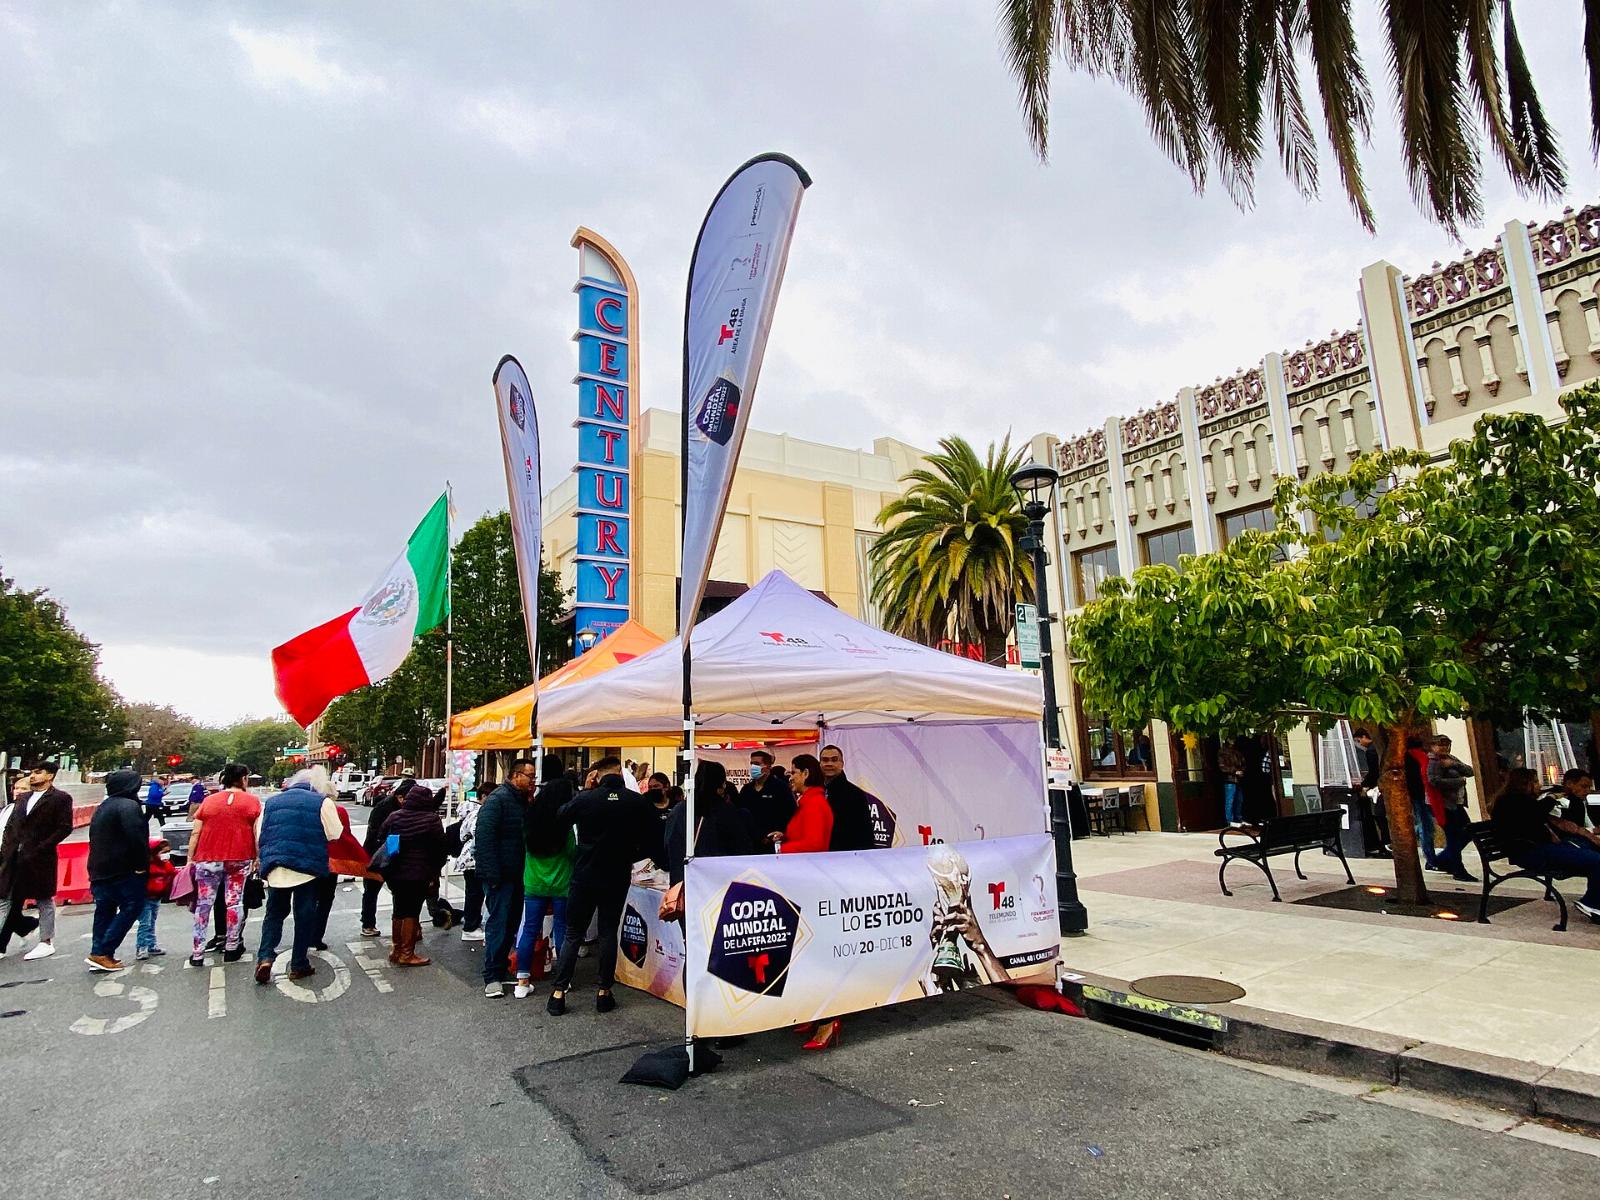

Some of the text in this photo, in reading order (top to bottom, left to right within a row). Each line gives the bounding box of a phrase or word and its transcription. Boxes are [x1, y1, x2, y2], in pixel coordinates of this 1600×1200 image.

[707, 386, 722, 432] MUNDIAL
[594, 297, 625, 602] CENTURY
[1018, 607, 1025, 620] 2
[731, 899, 778, 920] COPA
[818, 892, 912, 917] EL MUNDIAL
[1001, 896, 1015, 909] 48
[842, 908, 923, 932] LO ES TODO
[989, 911, 1016, 920] TELEMUNDO
[723, 918, 787, 938] MUNDIAL
[724, 940, 735, 950] DE
[736, 938, 748, 948] LA
[748, 936, 766, 947] FIFA
[833, 943, 858, 958] NOV
[900, 935, 912, 947] 18
[1009, 957, 1027, 965] CANAL
